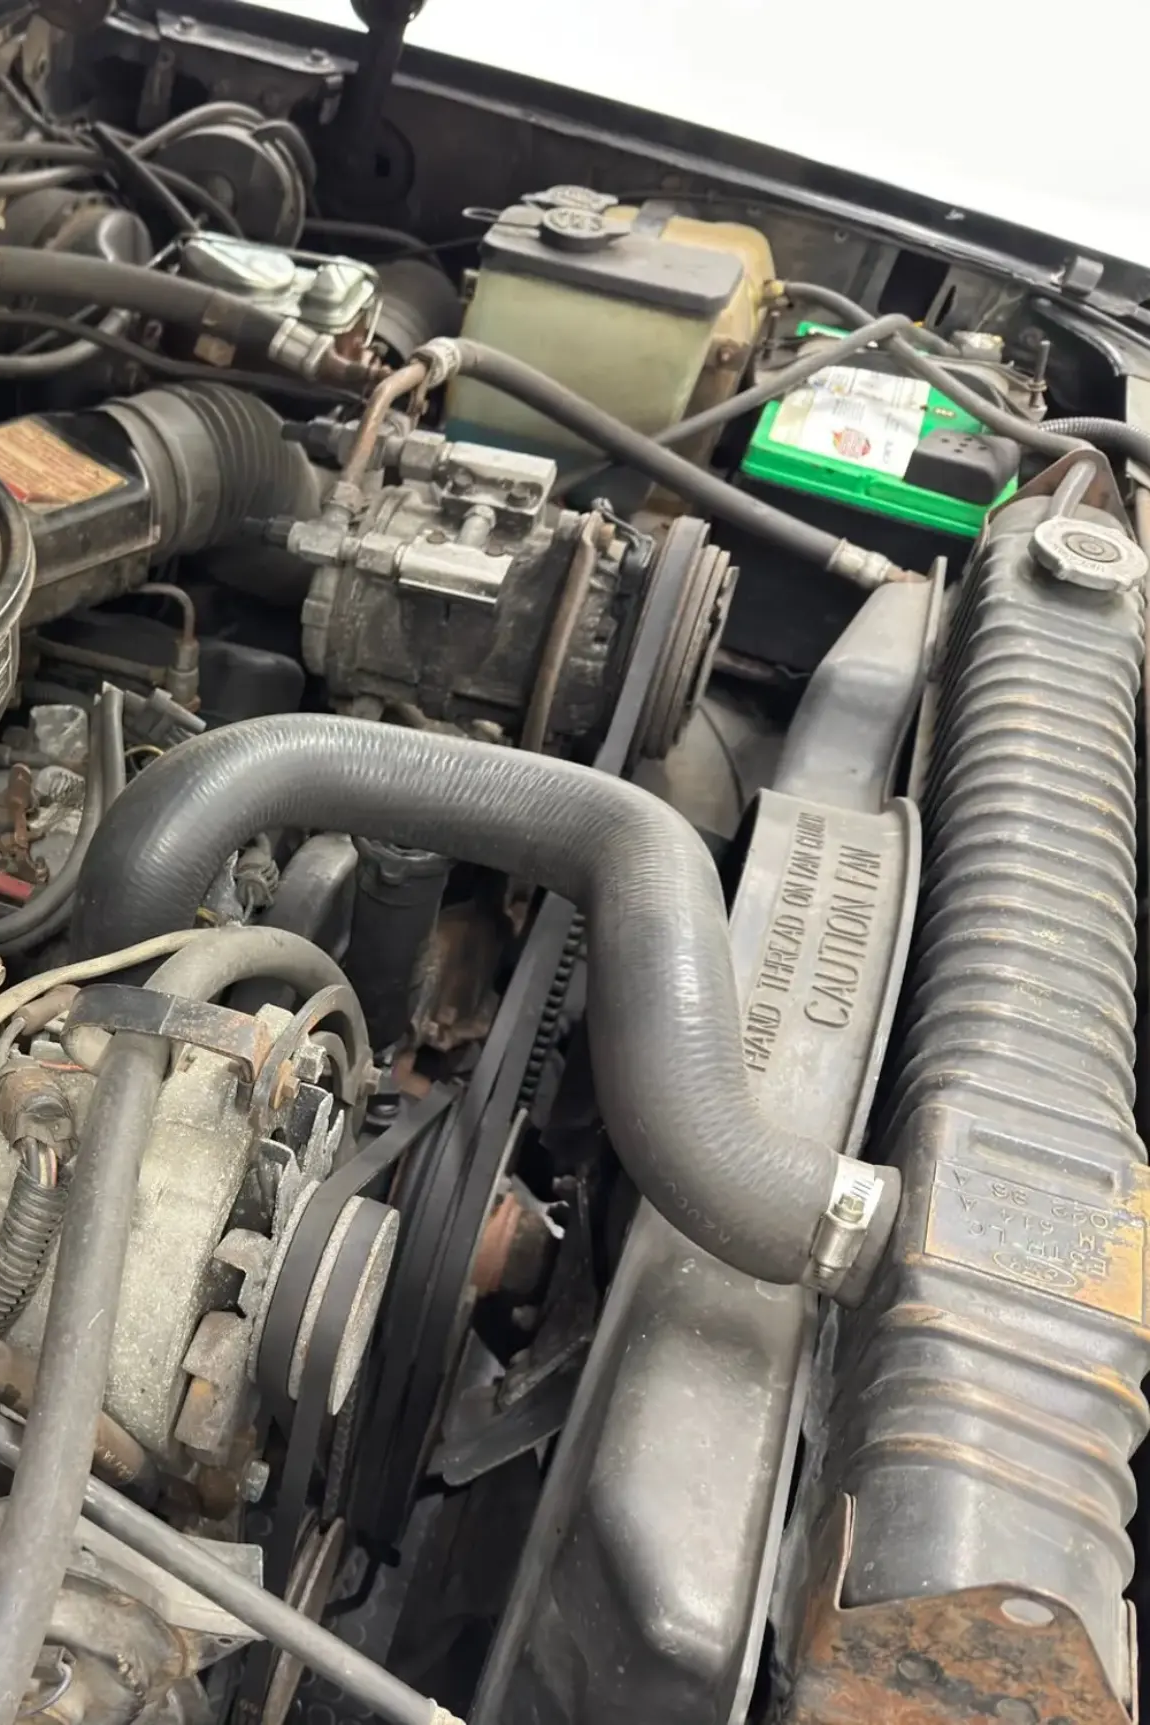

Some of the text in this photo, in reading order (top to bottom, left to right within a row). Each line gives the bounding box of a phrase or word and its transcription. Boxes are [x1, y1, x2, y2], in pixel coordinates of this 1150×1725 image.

[782, 881, 816, 908] ON
[756, 915, 805, 992] THREAD
[803, 845, 881, 1029] CAUTION FAN
[743, 1002, 782, 1072] HAND
